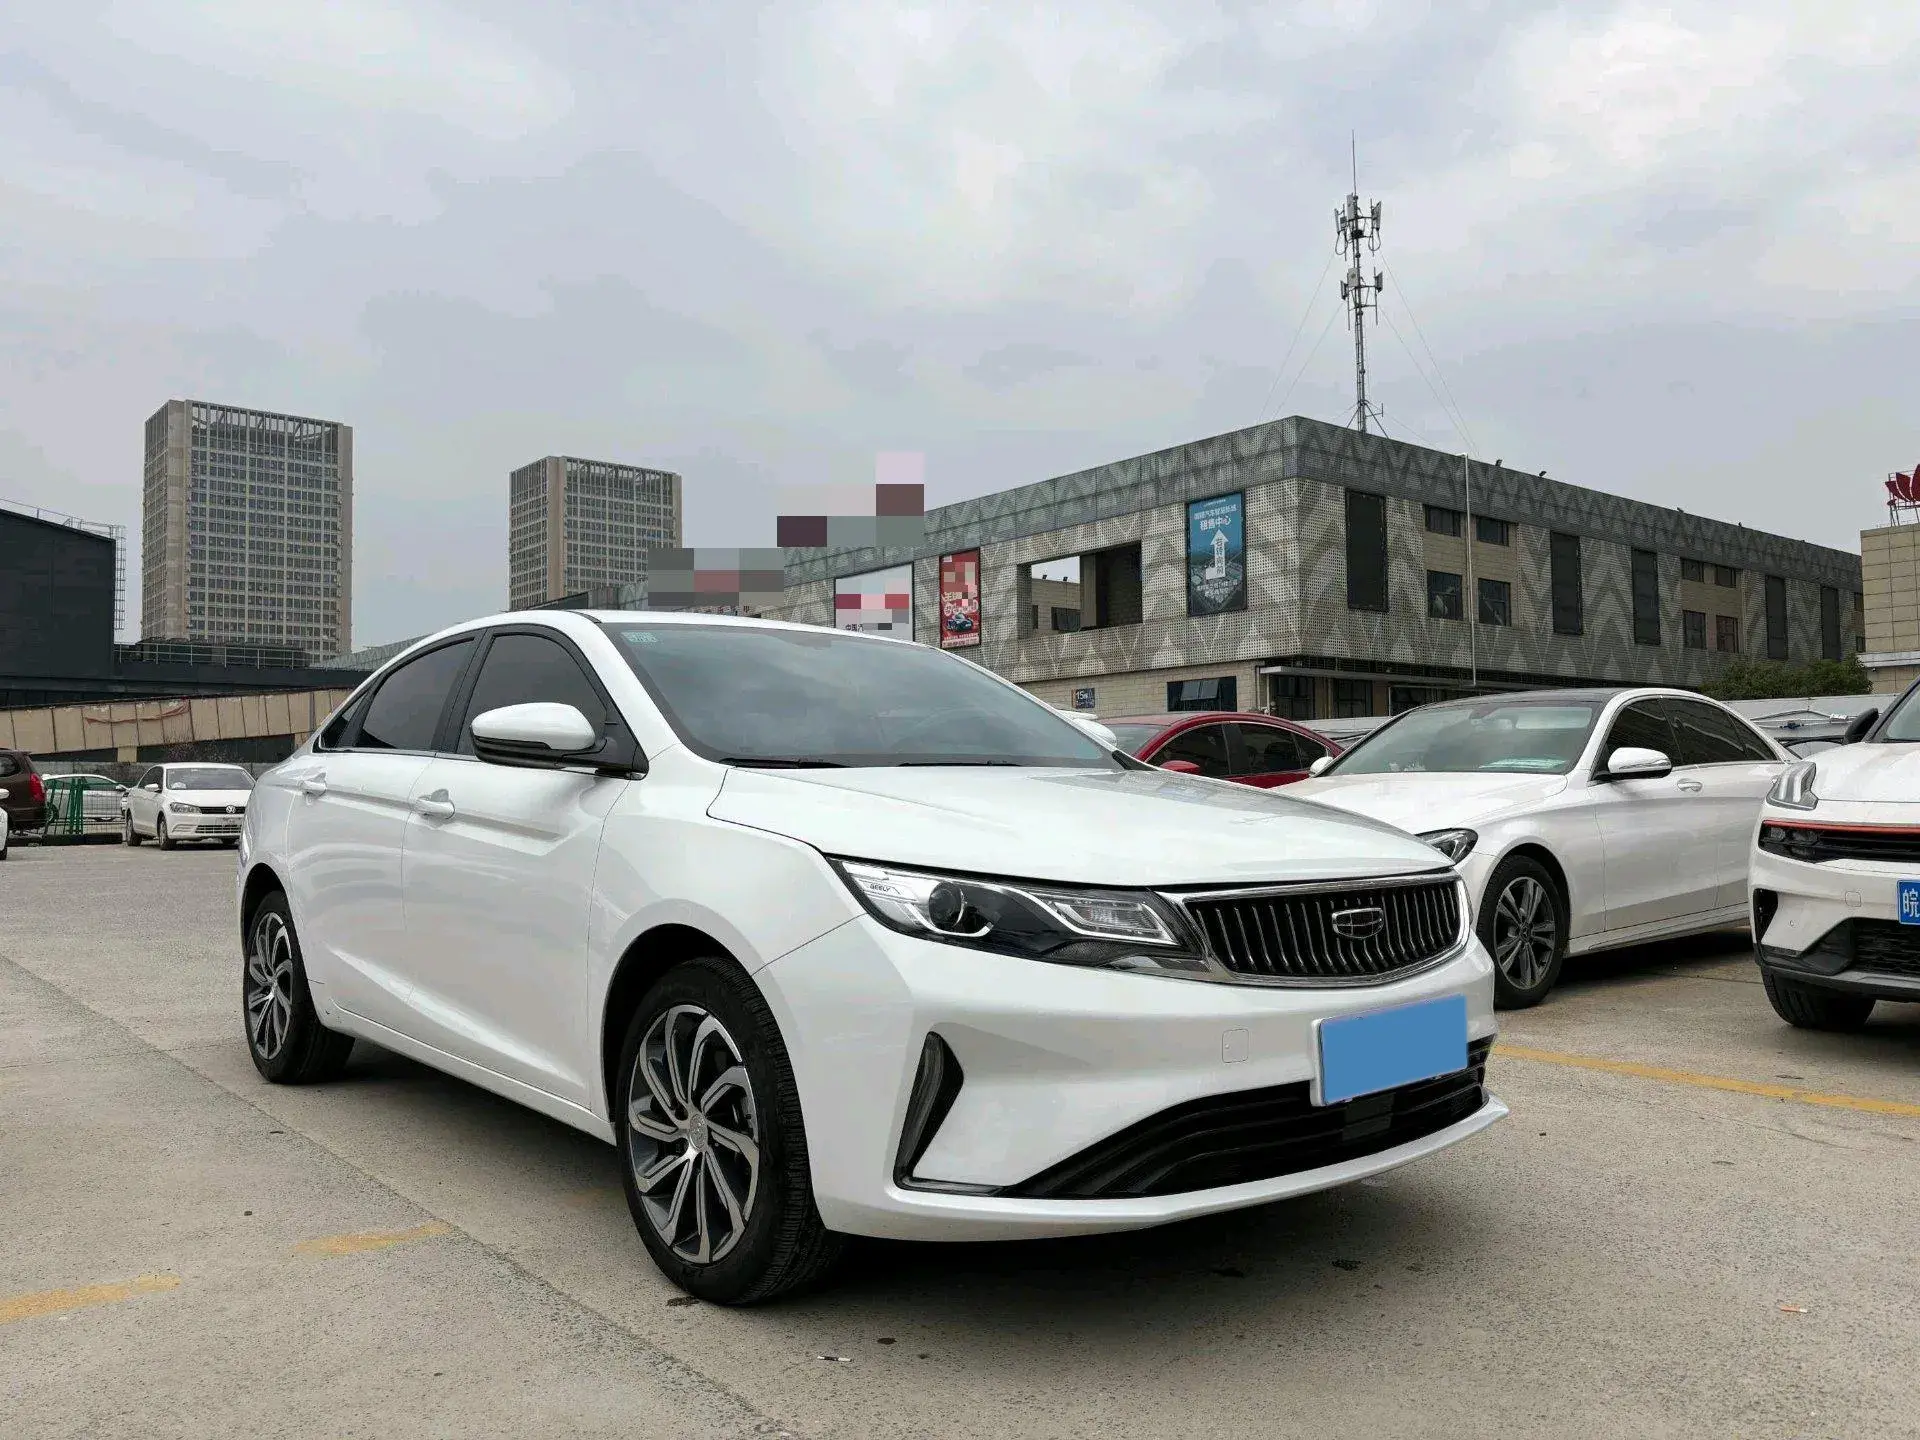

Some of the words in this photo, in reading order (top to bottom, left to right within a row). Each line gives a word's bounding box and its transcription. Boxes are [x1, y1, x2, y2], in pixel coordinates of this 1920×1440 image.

[1200, 515, 1231, 530] 租售中心
[870, 882, 890, 891] GEELY
[1903, 888, 1920, 917] 皖
